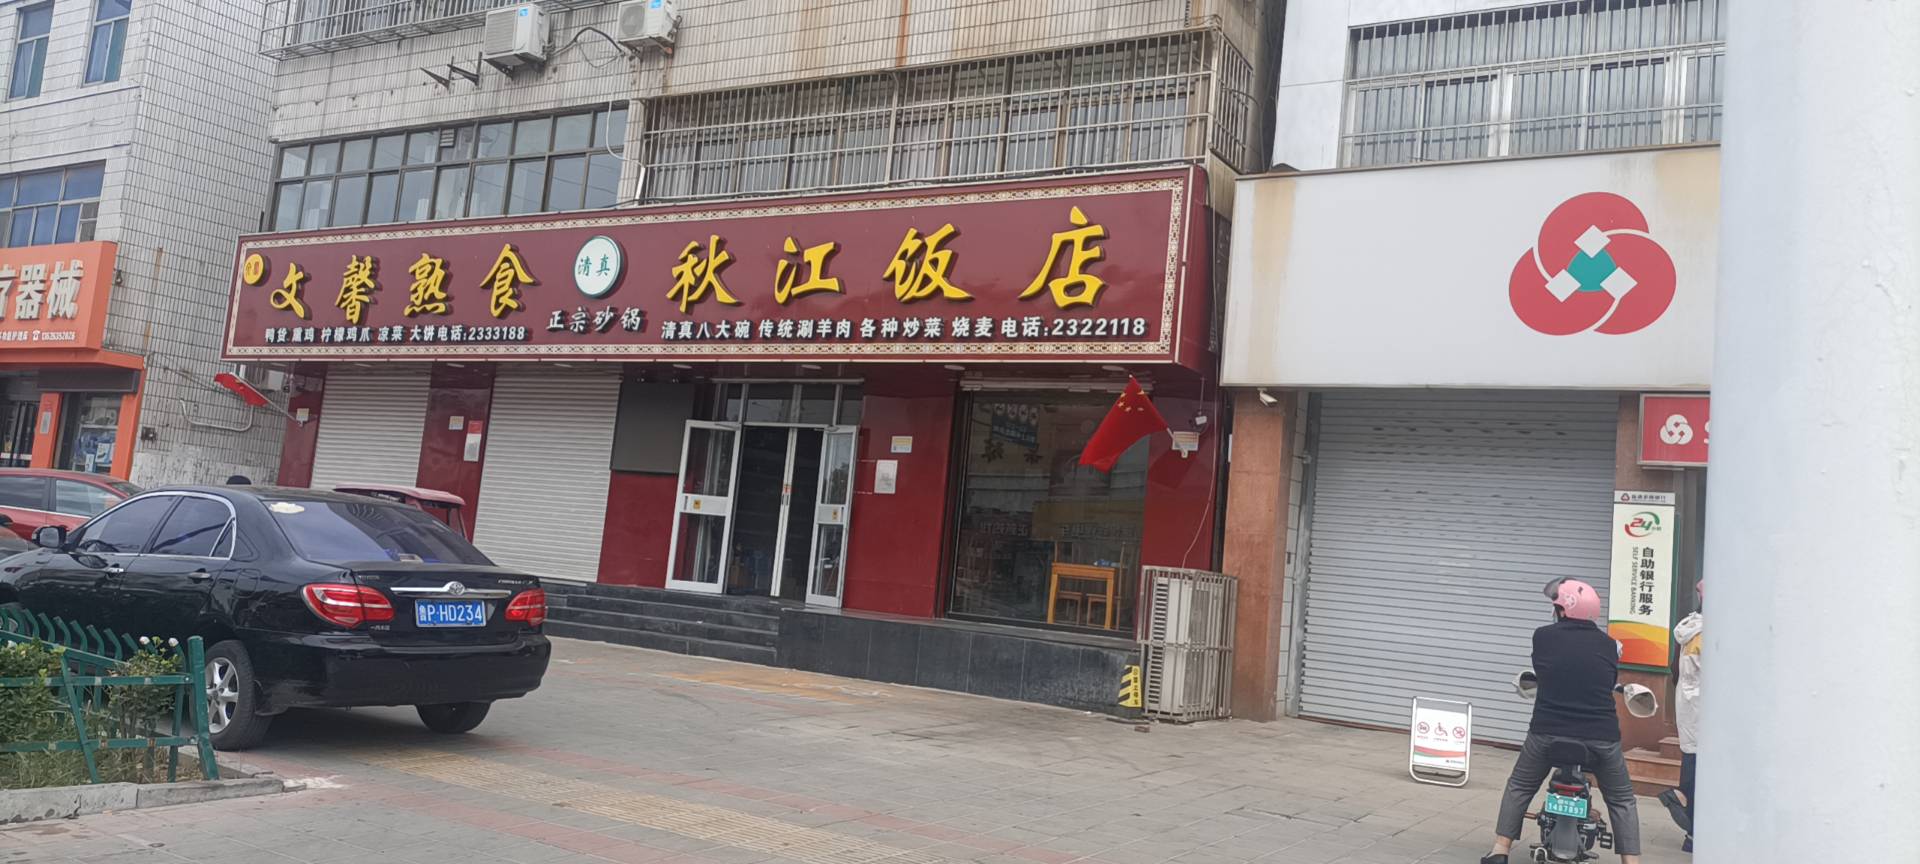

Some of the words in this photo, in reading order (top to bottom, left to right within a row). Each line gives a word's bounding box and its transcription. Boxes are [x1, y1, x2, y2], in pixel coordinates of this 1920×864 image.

[578, 253, 611, 277] 清真
[666, 205, 1105, 313] 秋江饭店
[270, 243, 535, 325] 文馨熟食
[546, 305, 641, 333] 正宗砂锅
[661, 319, 750, 339] 清真八大碗
[758, 318, 851, 339] 传统涮羊肉
[860, 317, 942, 338] 各种炒菜
[952, 316, 993, 338] 烧麦
[378, 326, 404, 342] 凉菜
[1630, 517, 1653, 531] 24
[1638, 546, 1655, 616] 自助银行服务
